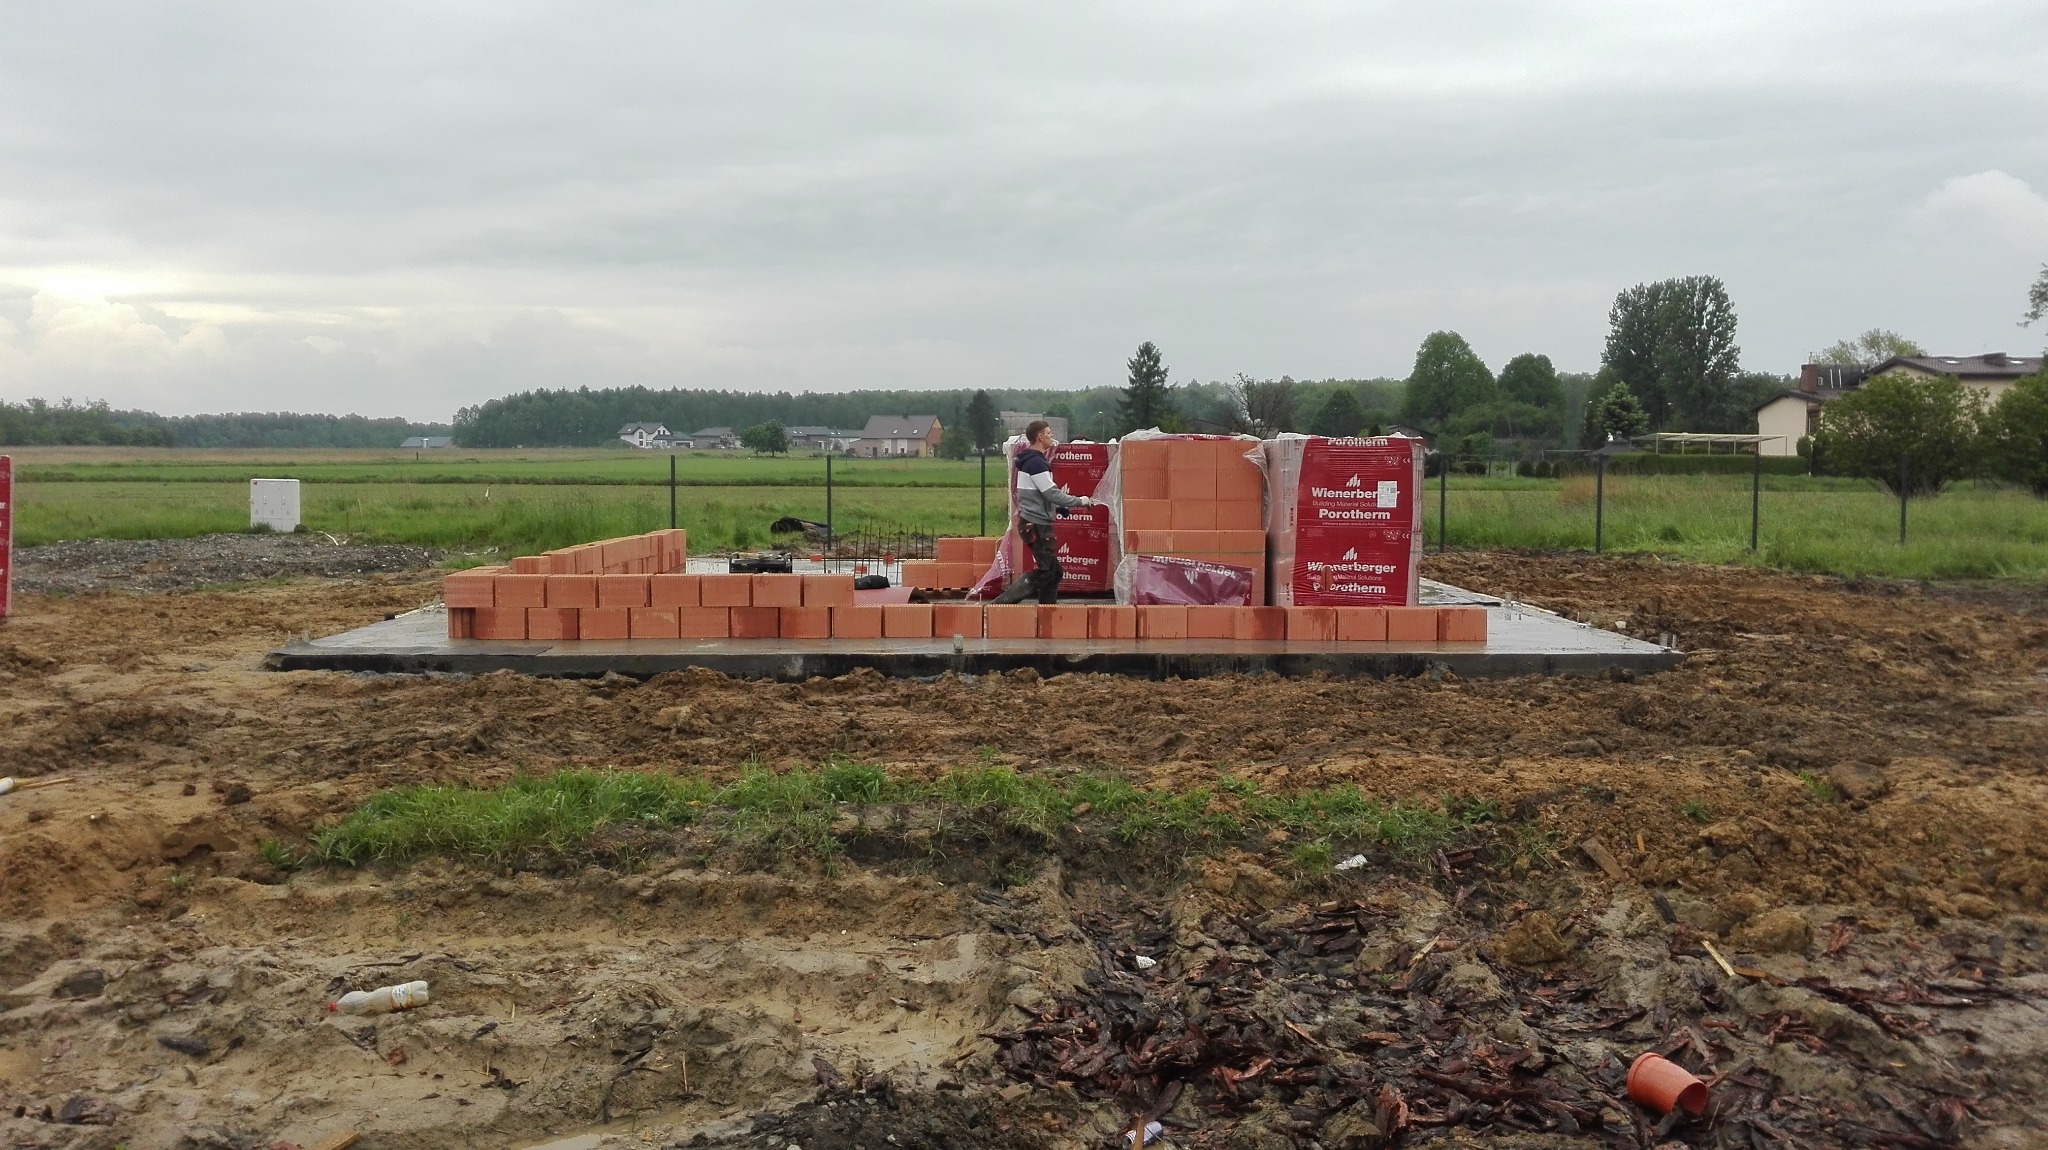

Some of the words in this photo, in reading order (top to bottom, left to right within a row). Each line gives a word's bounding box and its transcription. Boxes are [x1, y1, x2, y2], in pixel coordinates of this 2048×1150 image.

[1327, 437, 1388, 447] Porotherm
[1055, 451, 1092, 460] rotherm
[1311, 487, 1400, 499] Wienerber
[1312, 500, 1336, 508] Building
[1318, 508, 1391, 520] Porotherm
[1307, 561, 1396, 574] Winerberger
[1062, 571, 1091, 581] therm
[1357, 574, 1382, 582] Solutions
